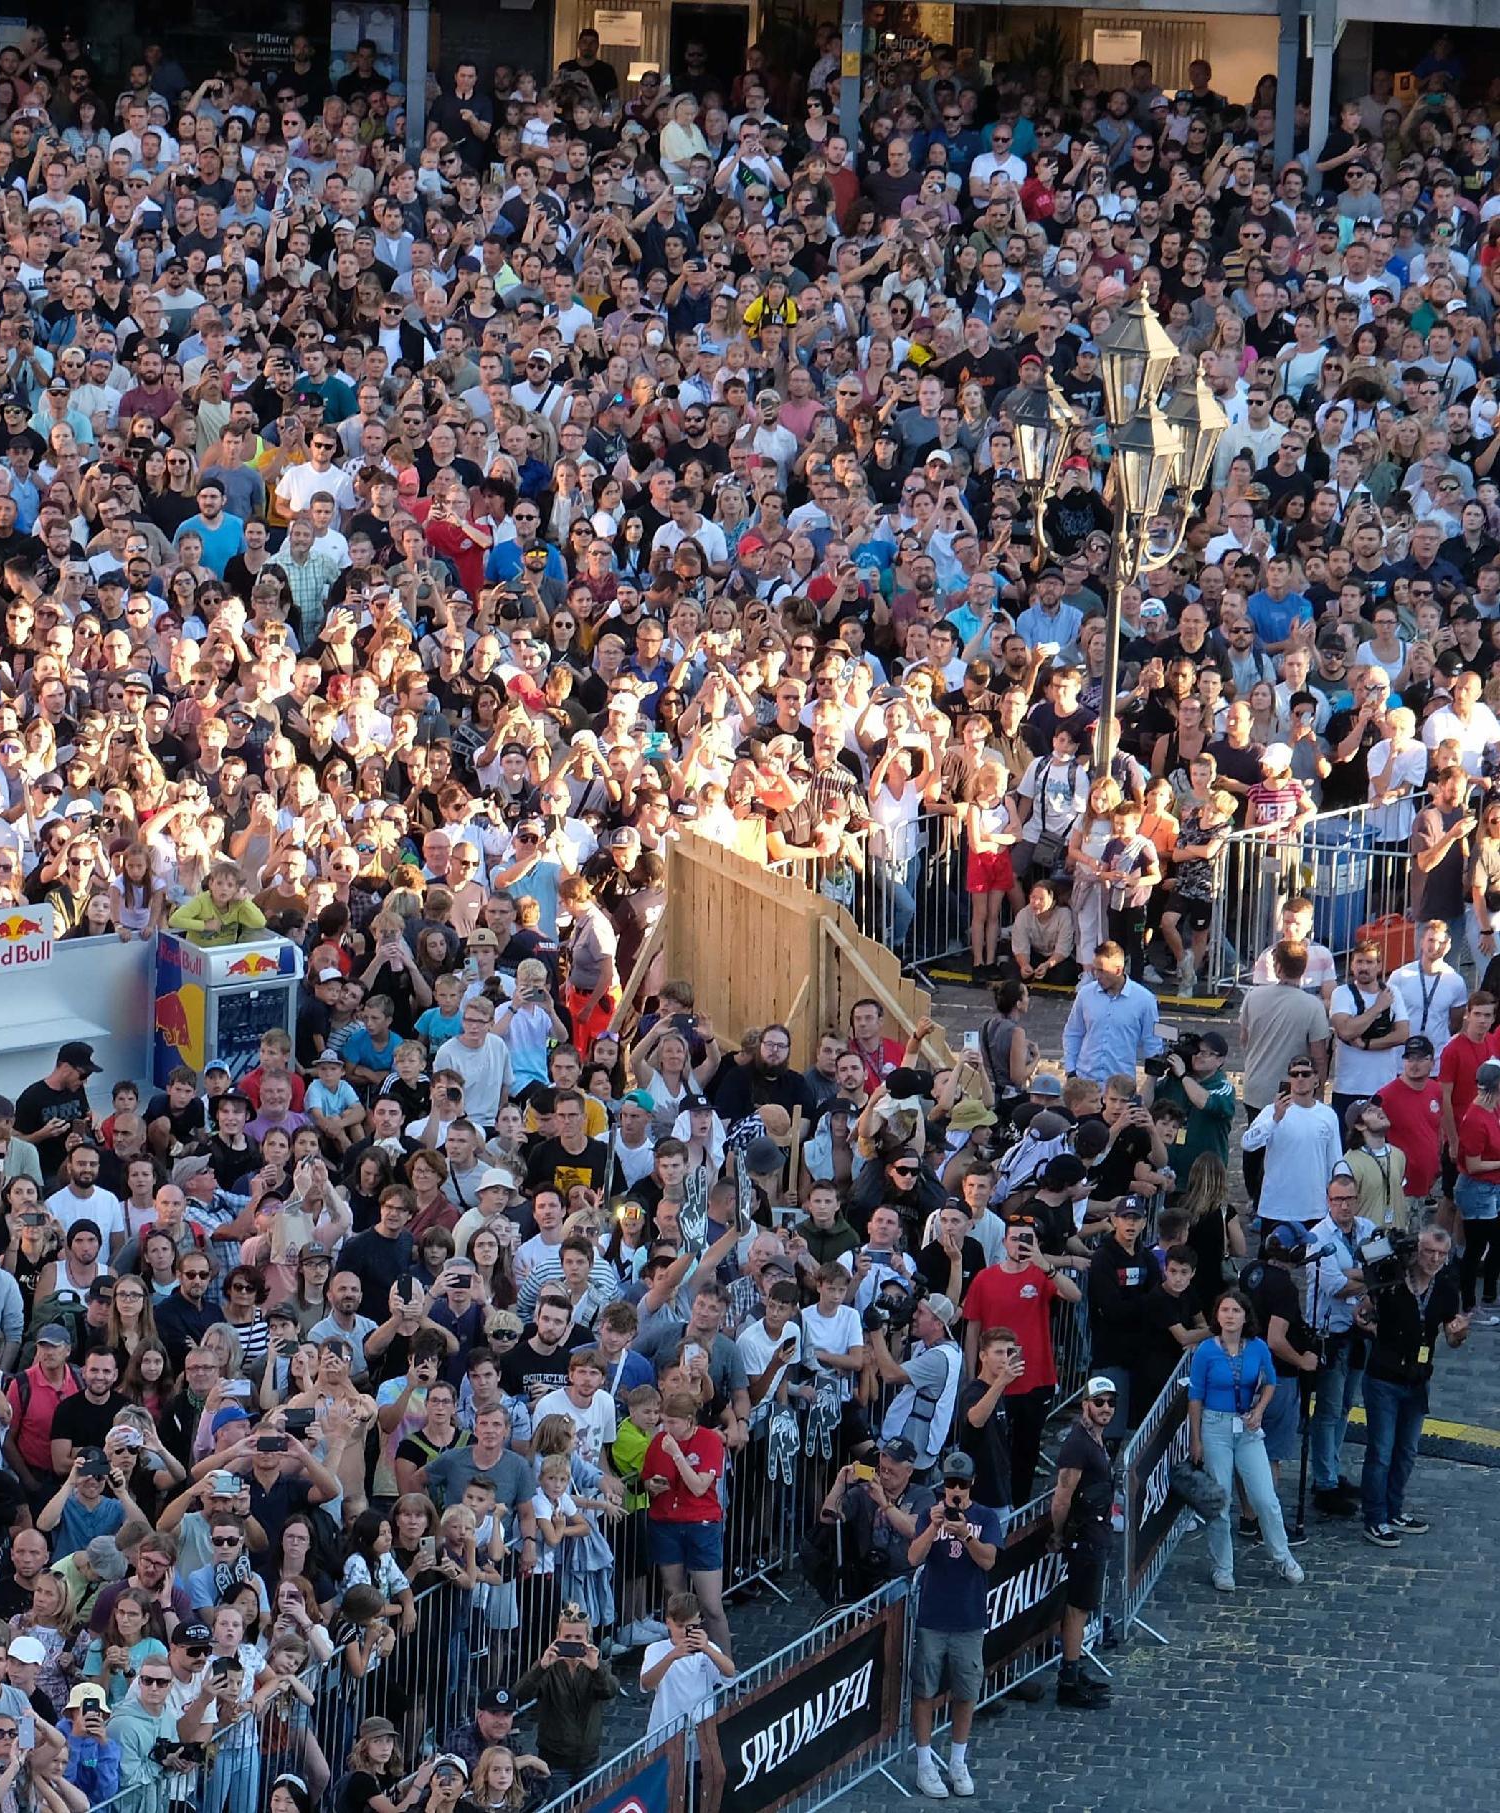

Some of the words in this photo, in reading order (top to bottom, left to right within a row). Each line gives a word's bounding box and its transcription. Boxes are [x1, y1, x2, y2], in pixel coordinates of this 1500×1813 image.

[15, 941, 50, 964] Bull
[182, 950, 202, 976] Bull
[734, 1659, 874, 1792] SPECIALIZED
